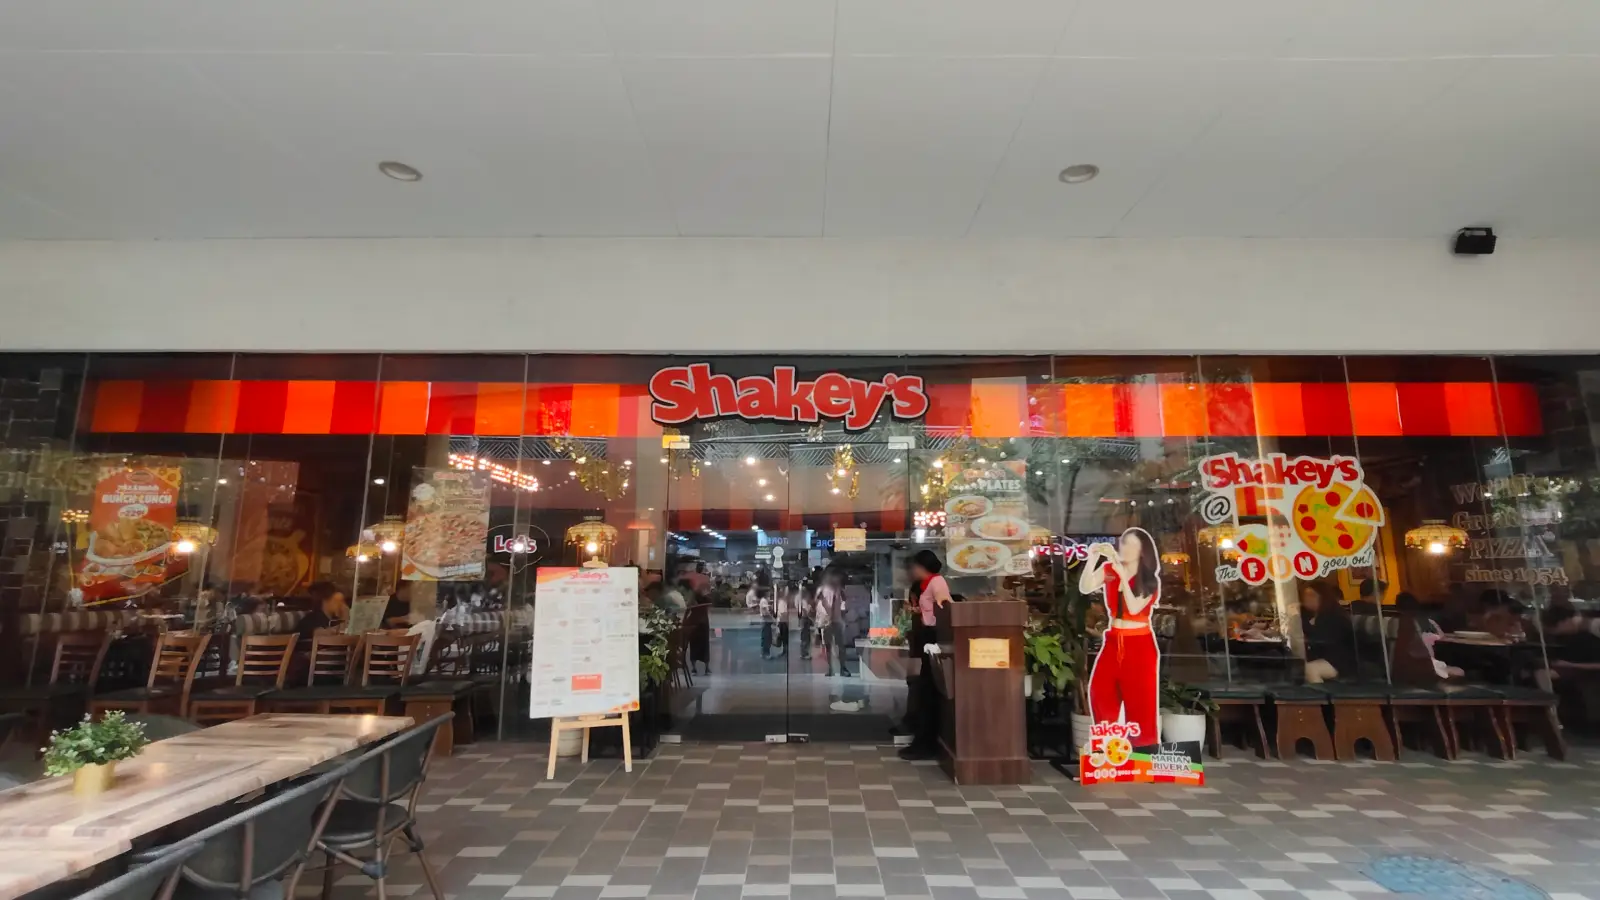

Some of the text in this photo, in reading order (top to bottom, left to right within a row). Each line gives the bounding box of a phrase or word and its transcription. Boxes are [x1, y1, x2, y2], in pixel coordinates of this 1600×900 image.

[650, 363, 928, 430] Shakey's
[1201, 455, 1360, 489] Shakey's
[1204, 496, 1231, 521] @
[1470, 535, 1554, 559] PIZZA
[1218, 568, 1238, 580] The
[1321, 558, 1348, 575] goes
[1352, 551, 1373, 566] on!
[1090, 721, 1140, 737] akey's
[1152, 755, 1192, 764] MARIAN
[1153, 762, 1190, 772] RIVERA
